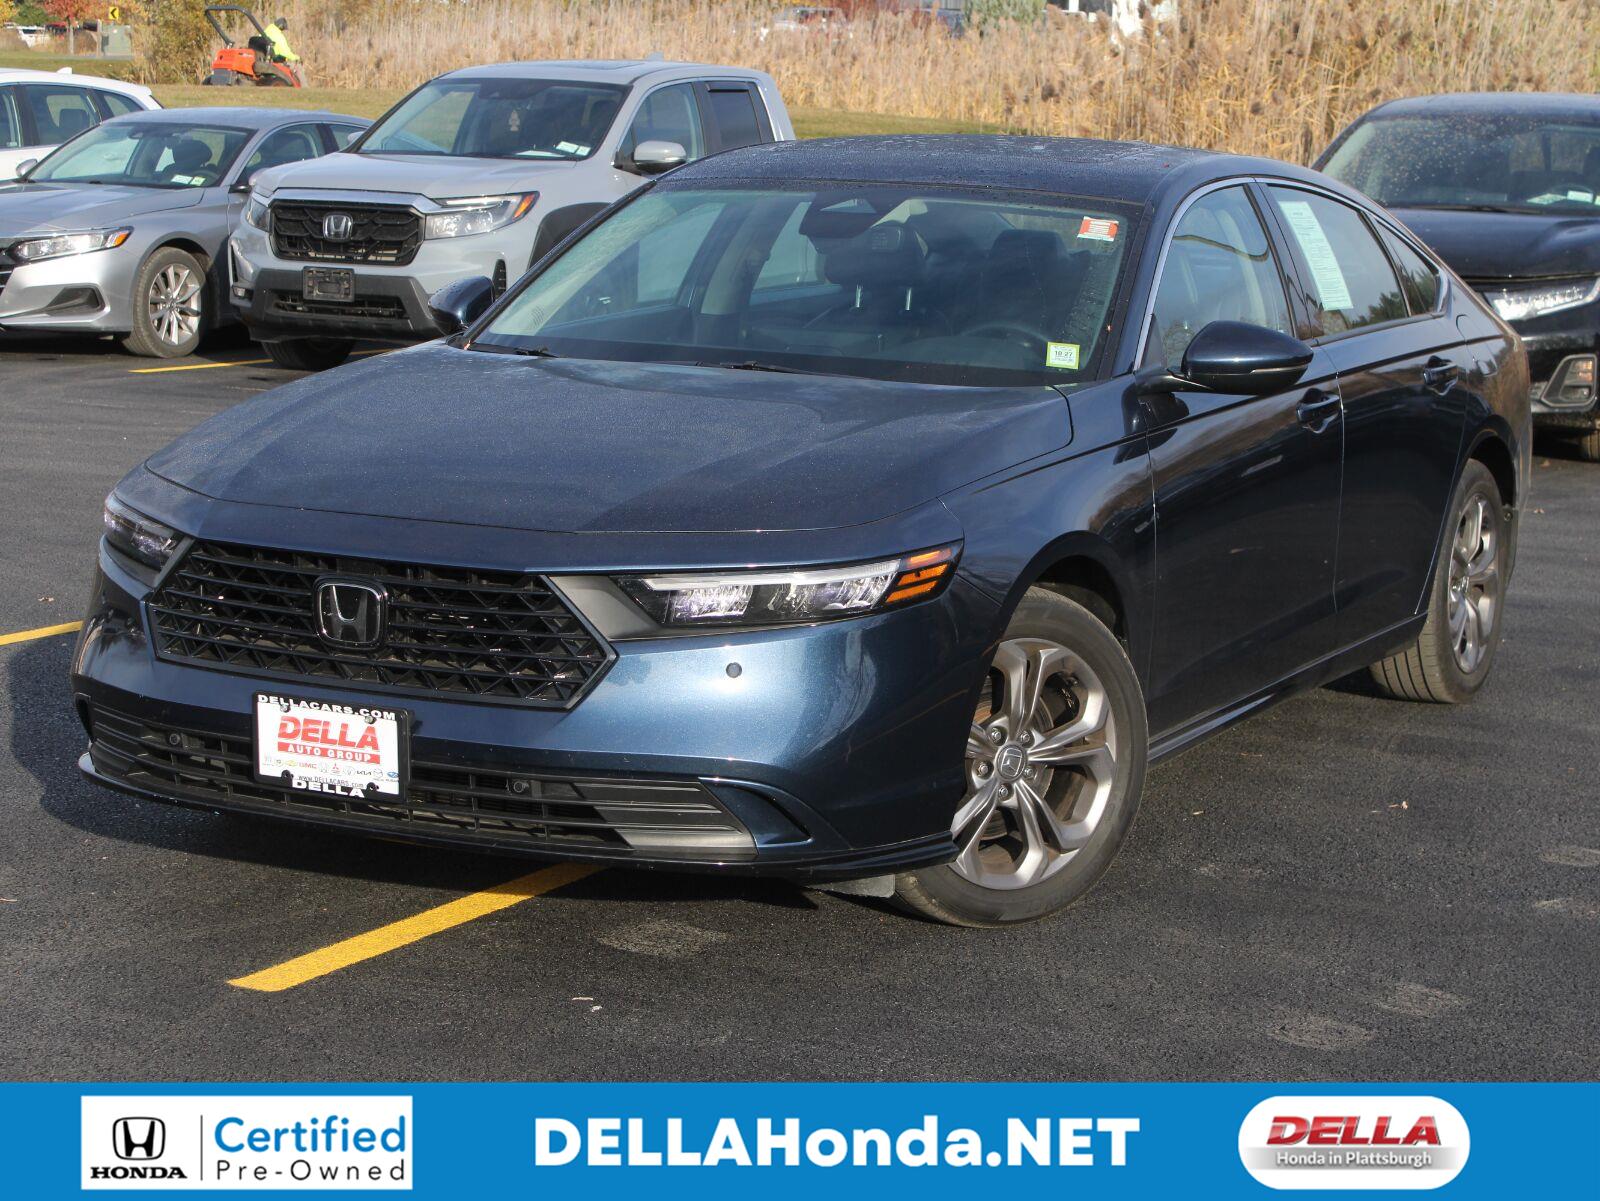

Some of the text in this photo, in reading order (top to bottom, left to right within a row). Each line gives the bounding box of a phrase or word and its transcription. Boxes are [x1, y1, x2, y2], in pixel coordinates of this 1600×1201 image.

[257, 694, 396, 720] DELLACARS.COM
[278, 715, 379, 751] DELLA
[287, 744, 371, 762] AUTO GROUP
[292, 780, 365, 798] DELLA
